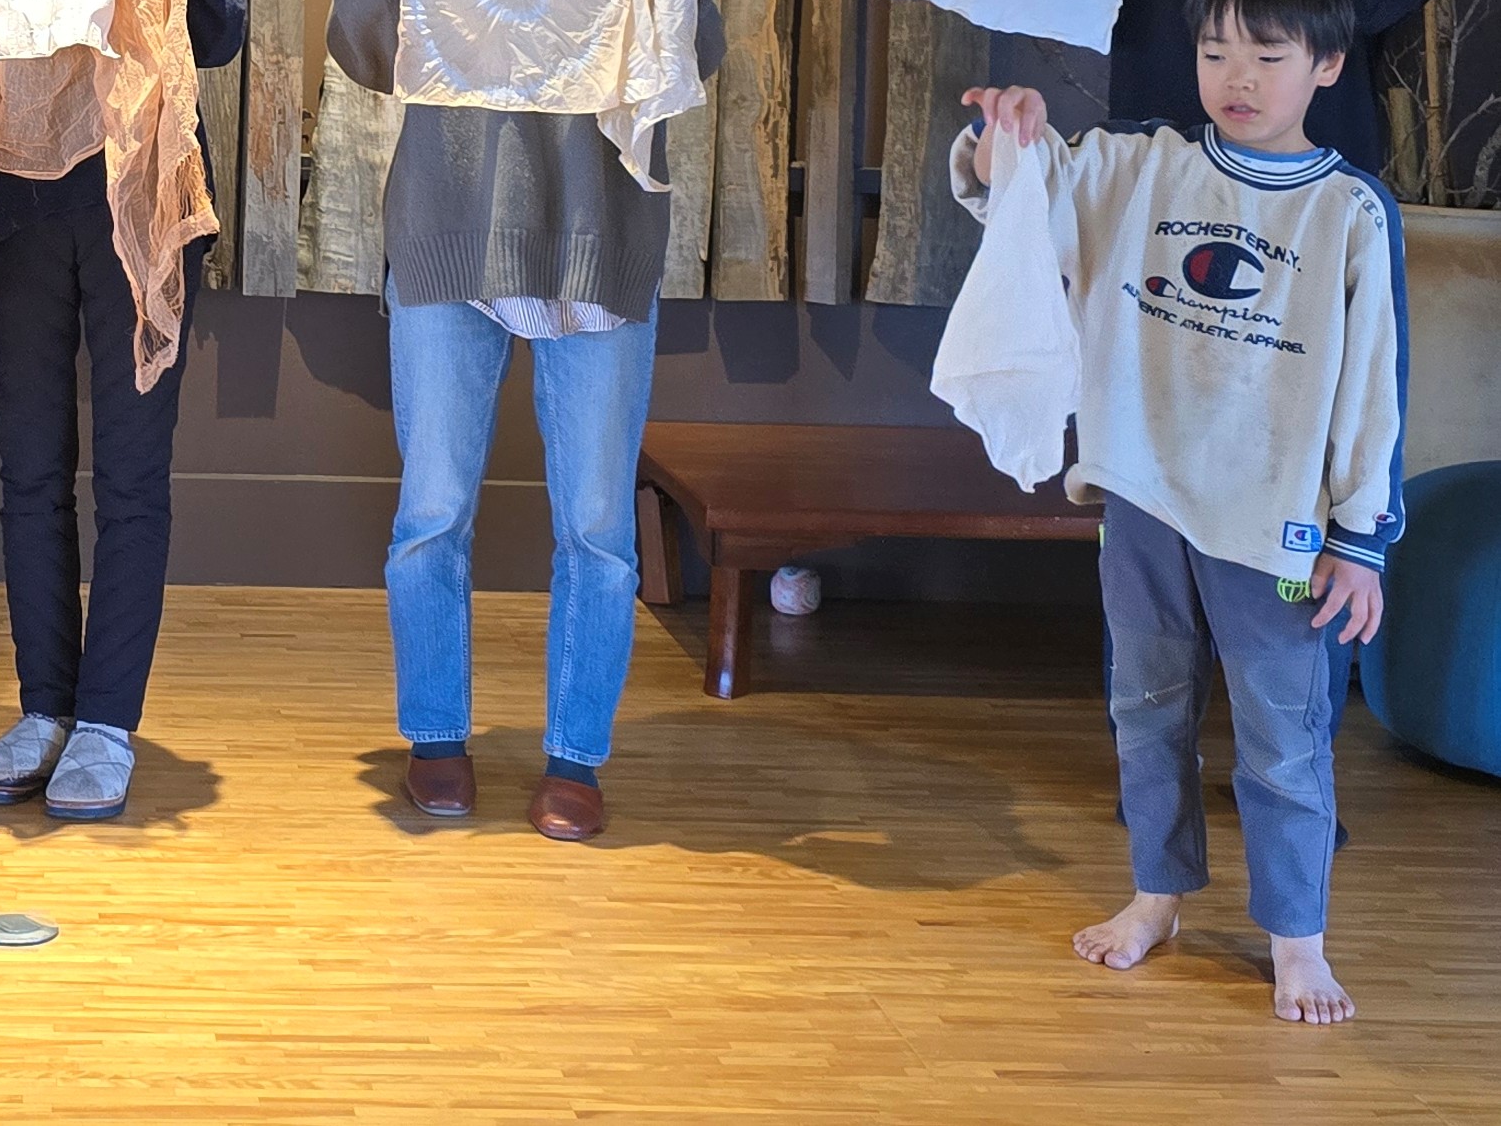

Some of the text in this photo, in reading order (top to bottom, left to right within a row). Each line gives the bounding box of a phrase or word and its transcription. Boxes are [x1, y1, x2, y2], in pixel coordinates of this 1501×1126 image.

[1145, 275, 1283, 327] Champion
[1179, 318, 1240, 342] ATHLETIC
[1243, 332, 1307, 355] APPAREL
